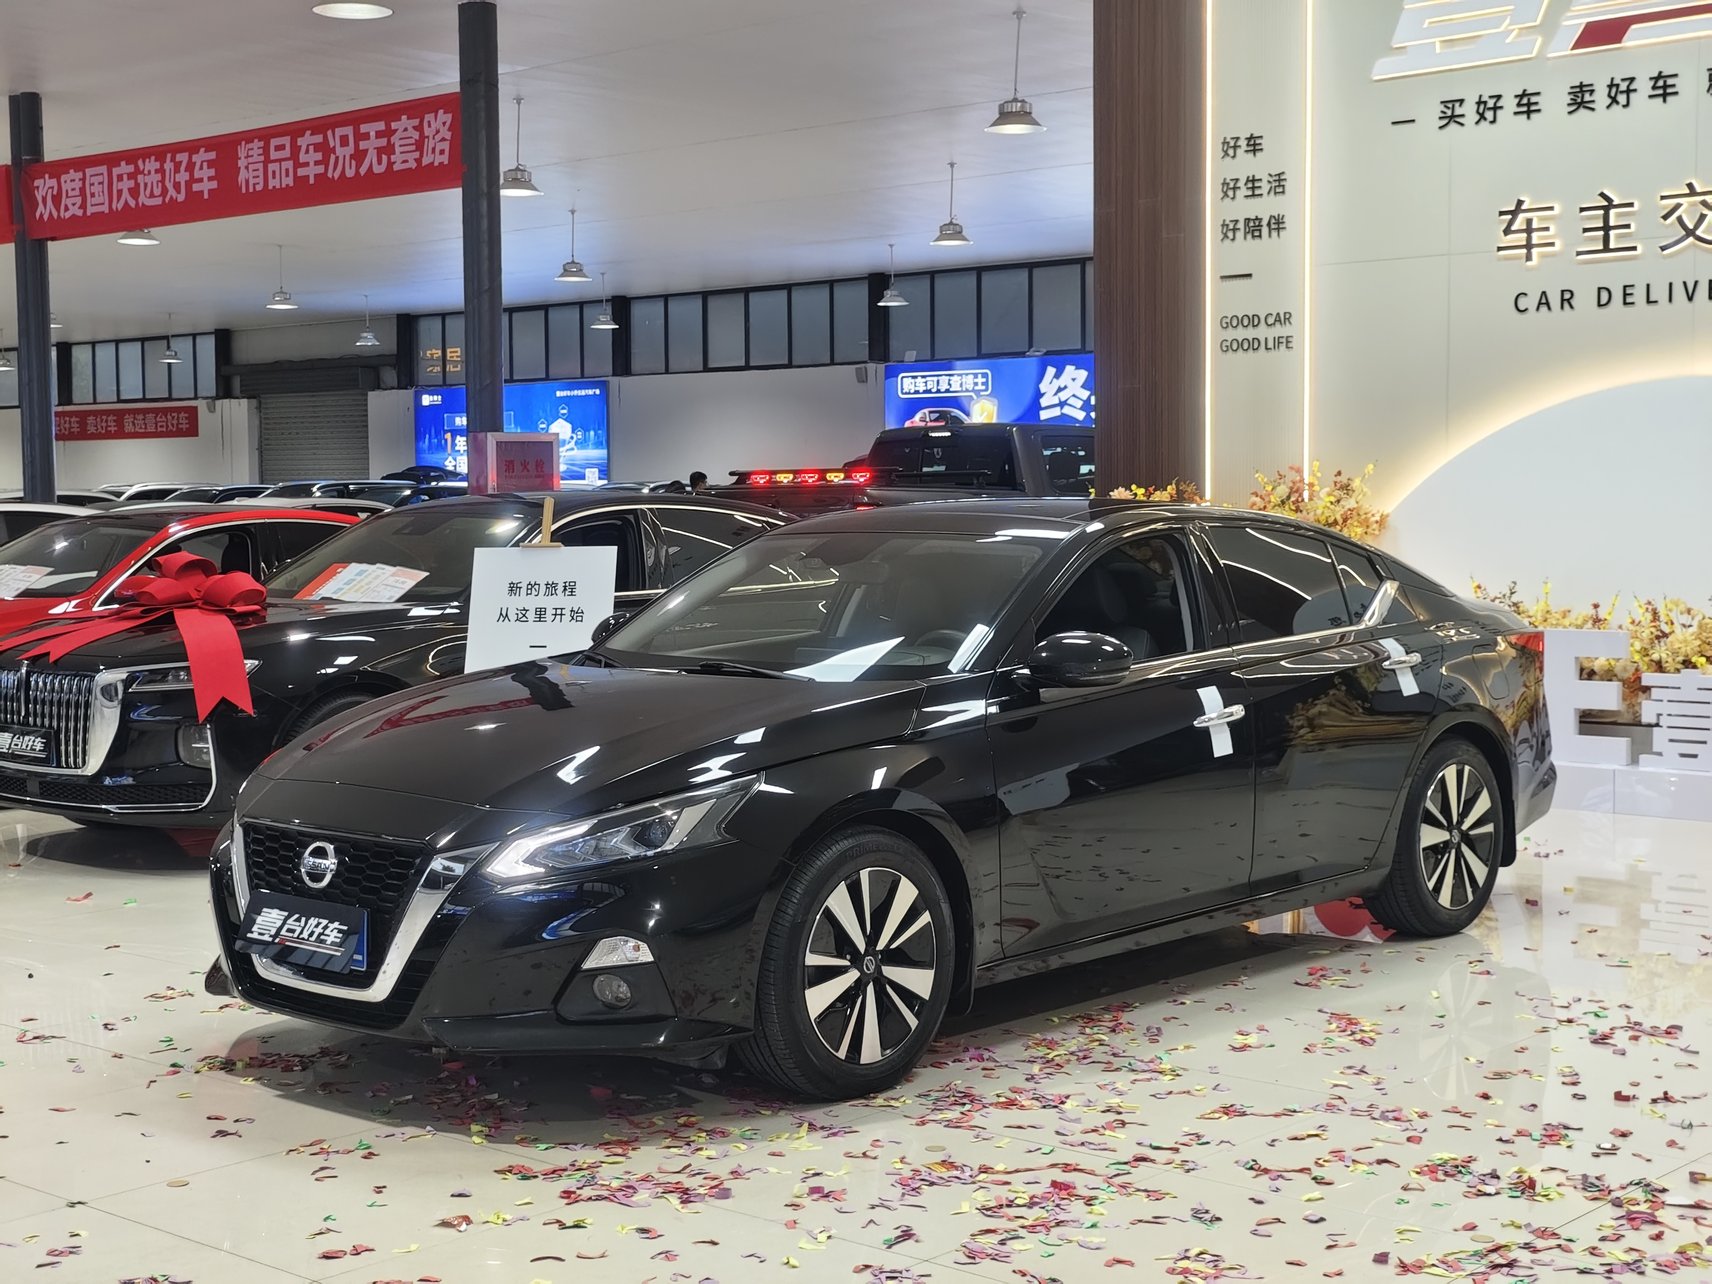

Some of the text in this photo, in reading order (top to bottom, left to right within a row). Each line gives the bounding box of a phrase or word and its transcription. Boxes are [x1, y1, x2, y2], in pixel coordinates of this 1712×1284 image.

[1438, 88, 1542, 130] 买好车
[1567, 70, 1680, 115] 卖好车
[1220, 133, 1264, 160] 好车
[34, 109, 454, 223] 欢度国庆选好车 精品车况无套路
[1220, 171, 1288, 201] 好生活
[1220, 213, 1287, 242] 好陪伴
[1514, 278, 1712, 313] CAR DELIV
[1220, 311, 1293, 330] GOOD CAR
[1220, 335, 1294, 353] GOOD LIFE
[902, 375, 986, 393] 购车可享查博士
[1038, 364, 1095, 421] 终
[507, 580, 577, 597] 新的旅程
[496, 606, 585, 623] 从这里开始
[246, 907, 349, 945] 壹台好车
